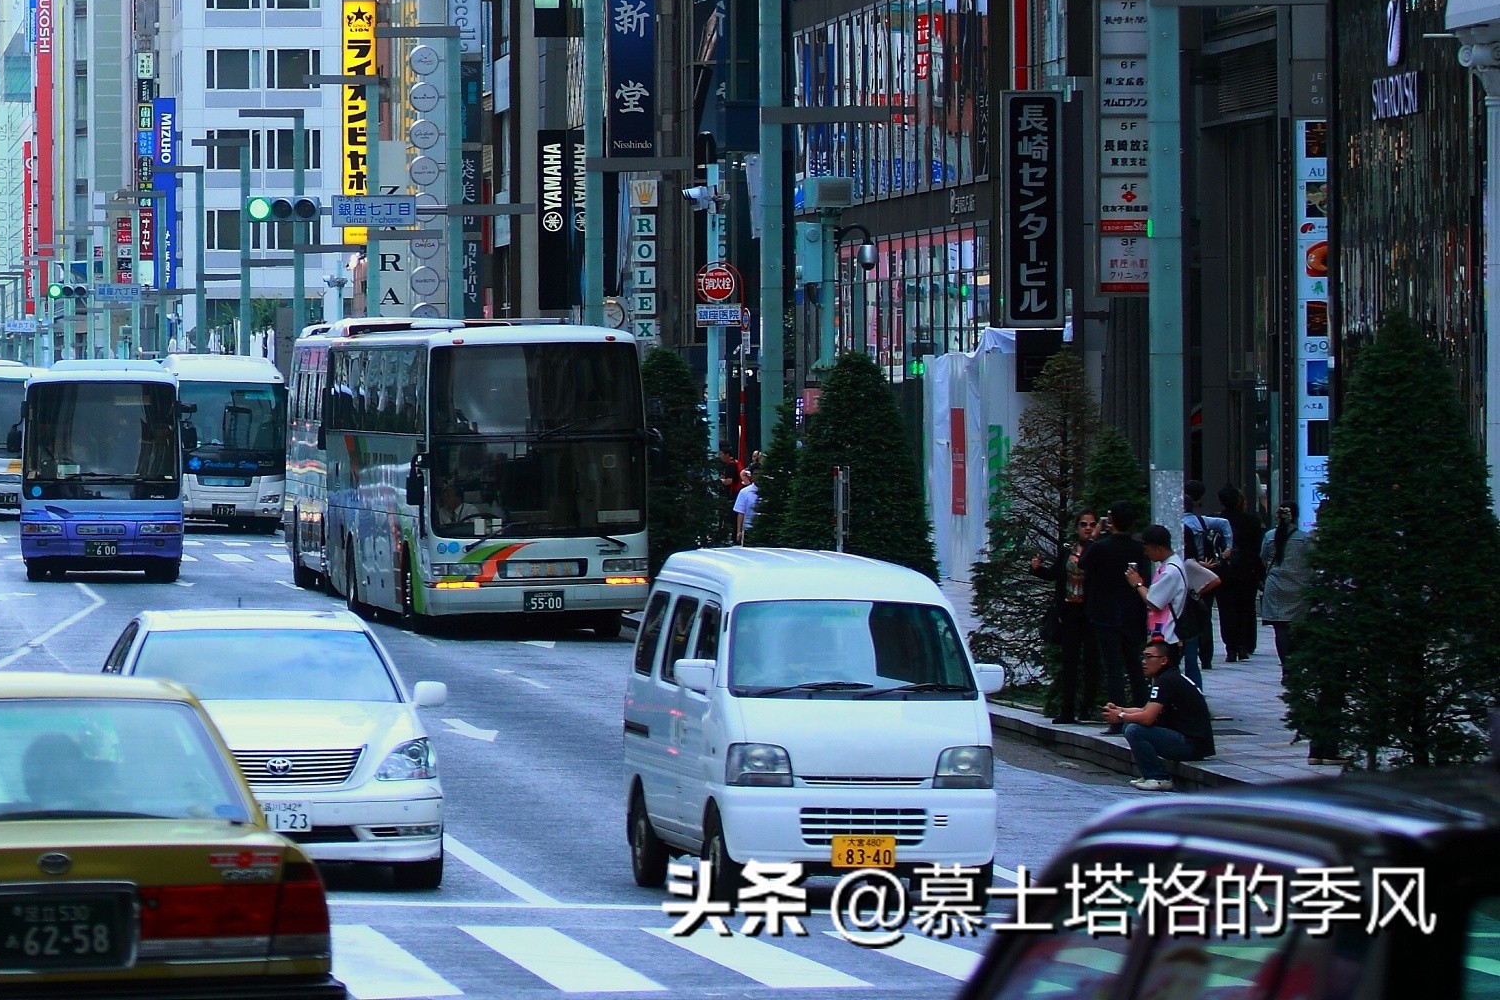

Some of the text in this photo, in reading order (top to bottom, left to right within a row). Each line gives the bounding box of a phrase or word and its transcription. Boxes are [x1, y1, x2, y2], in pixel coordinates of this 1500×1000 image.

[1121, 2, 1137, 10] 7F
[1121, 61, 1137, 69] 6F
[1371, 72, 1421, 122] SWAROVSKI
[1120, 122, 1138, 131] 5F
[161, 113, 172, 164] MIZUHO
[613, 139, 653, 150] Nisshindo
[543, 142, 562, 211] YAMAHA
[1120, 183, 1138, 192] 4F
[338, 203, 411, 216] 銀座七丁目
[1017, 104, 1049, 315] 長崎センタービル
[345, 215, 404, 224] Ginza 7-chome
[141, 218, 151, 250] ナカヤ
[414, 240, 436, 248] OMEGA
[1120, 238, 1138, 247] 3F
[637, 217, 653, 339] ROLEX
[705, 279, 732, 291] 消火栓
[98, 287, 139, 296] 銀座六丁目
[698, 309, 740, 320] 銀座医院
[530, 597, 562, 610] 55-00
[847, 837, 882, 847] 大宮480
[845, 849, 892, 865] 83-40
[22, 923, 112, 956] 62-58
